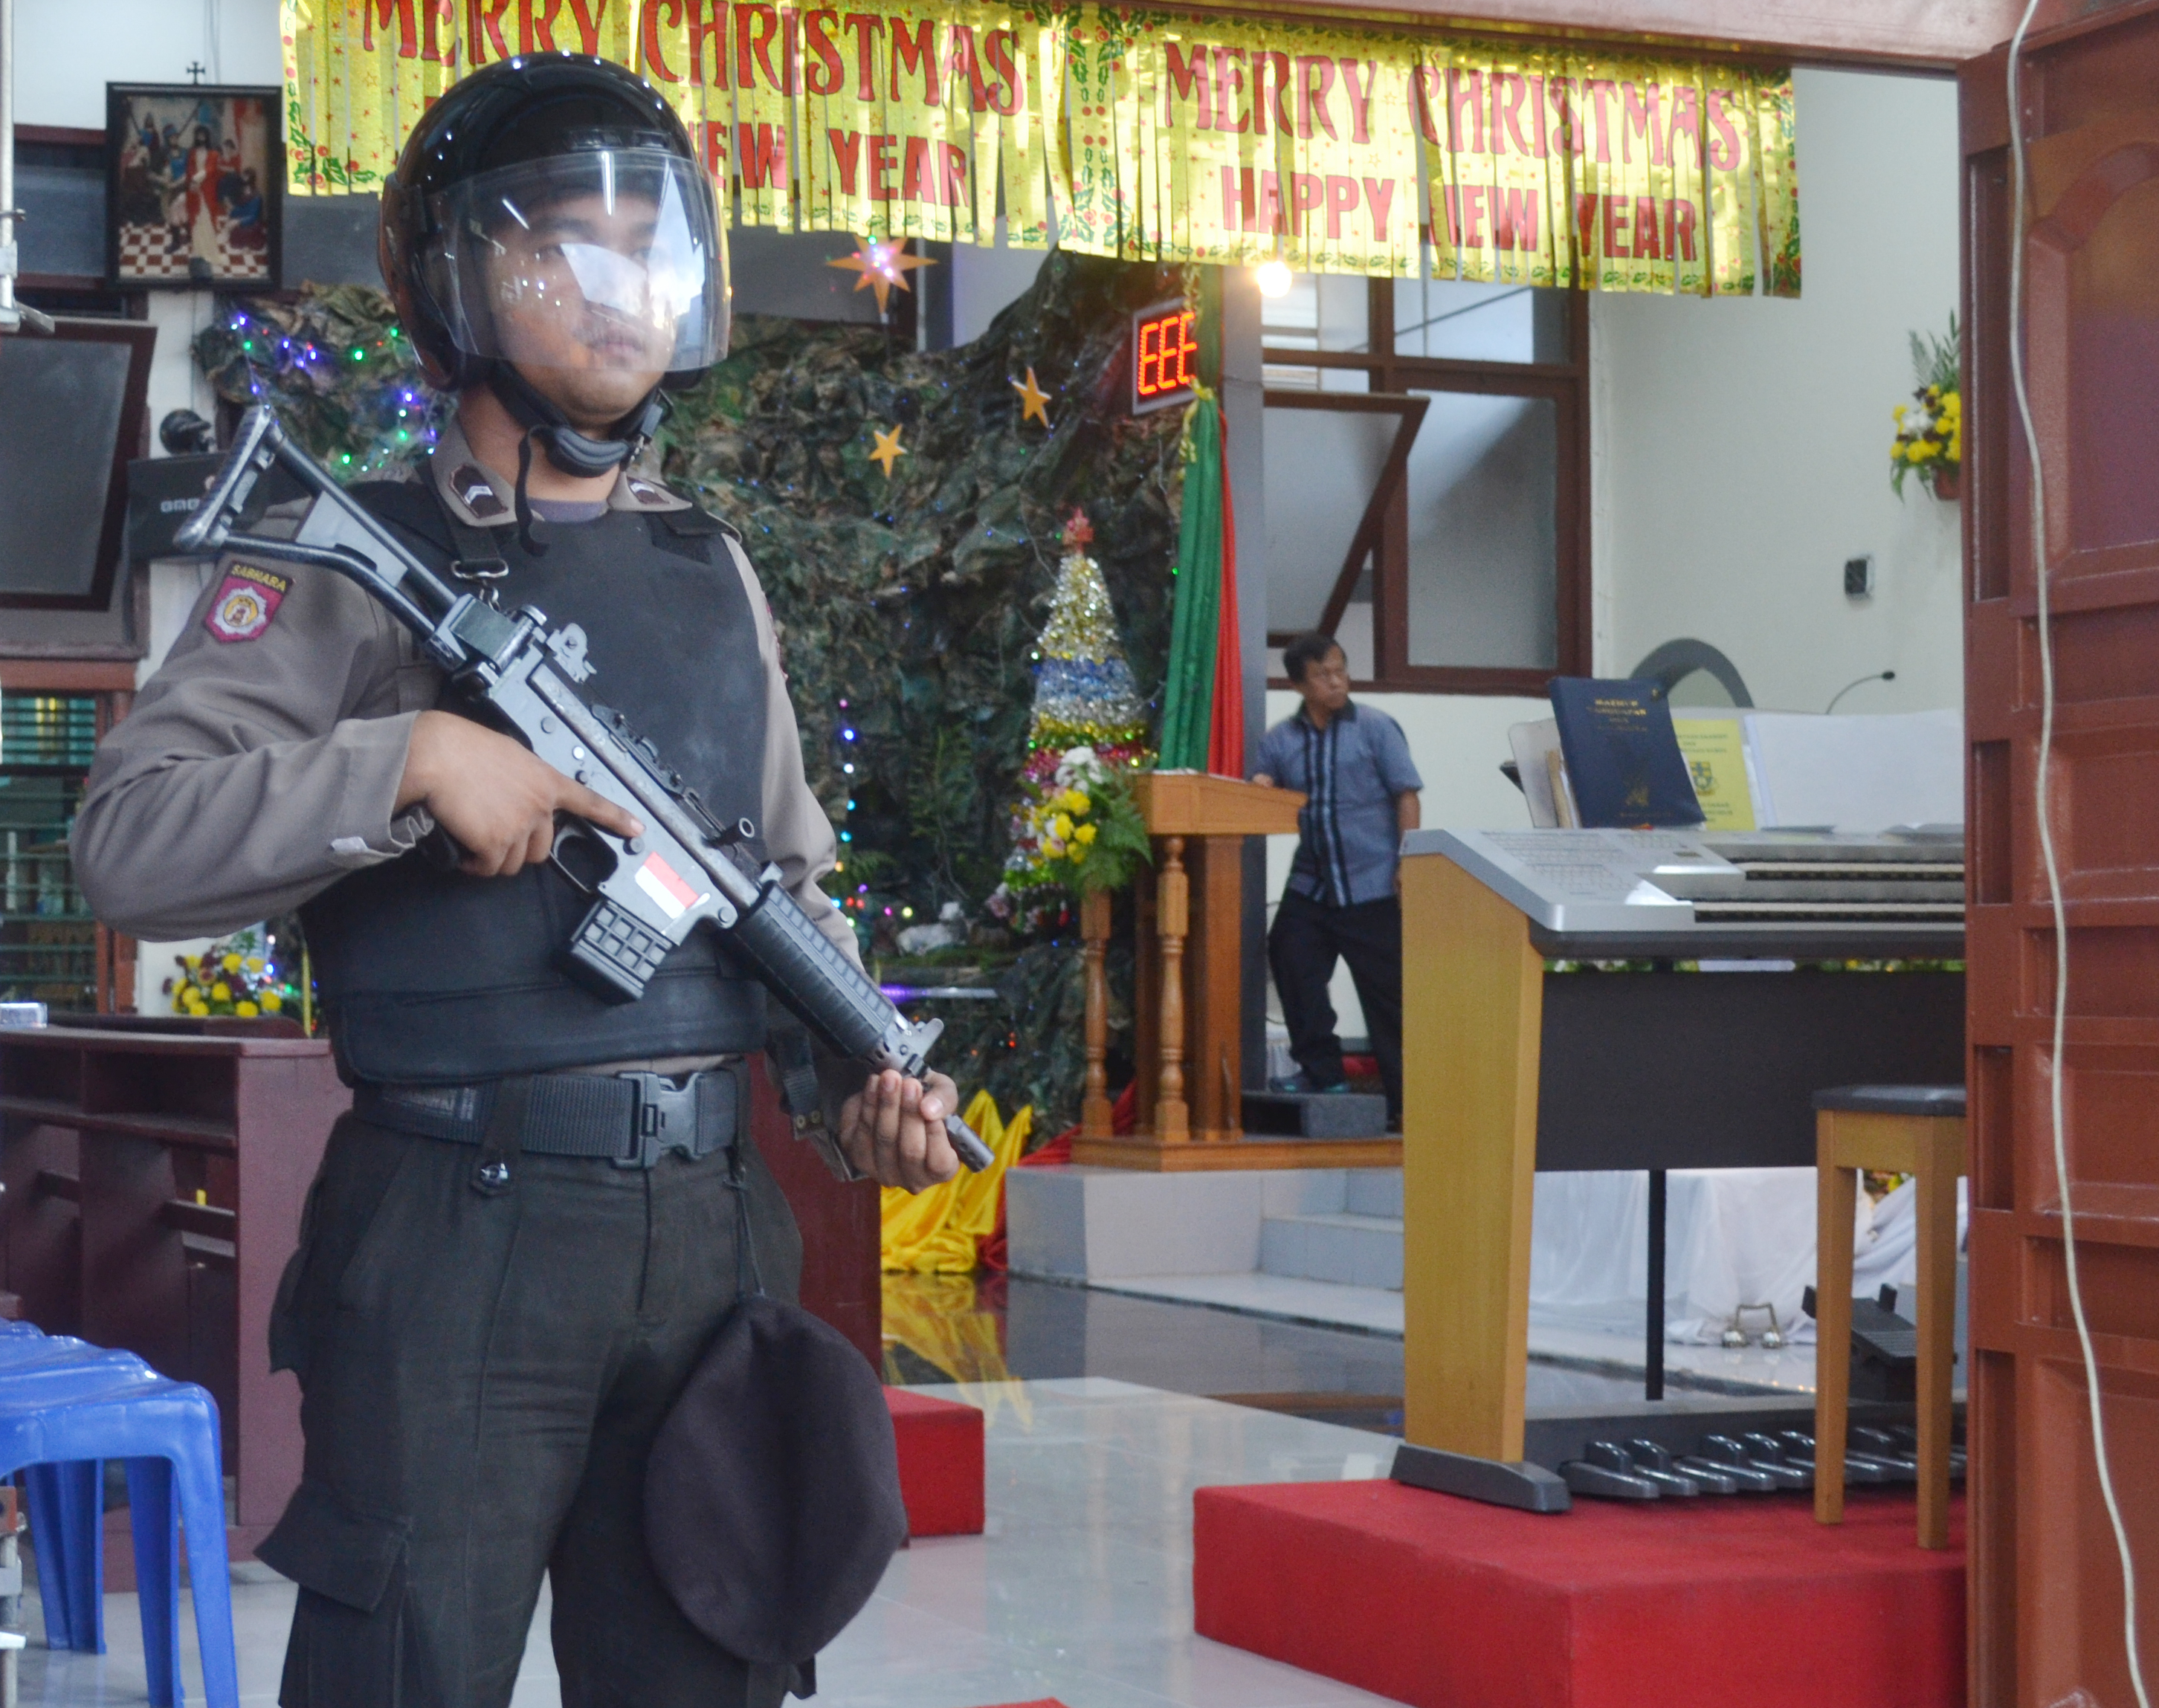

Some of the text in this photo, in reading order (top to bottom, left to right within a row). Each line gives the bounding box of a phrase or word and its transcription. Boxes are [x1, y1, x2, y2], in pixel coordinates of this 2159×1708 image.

[363, 0, 1024, 116] MERRY CHRISTMAS
[1164, 42, 1741, 171] MERRY CHRISTMAS
[688, 120, 969, 207] EW YEAR
[1221, 165, 1395, 242] HAPPY
[1575, 193, 1697, 262] YEAR
